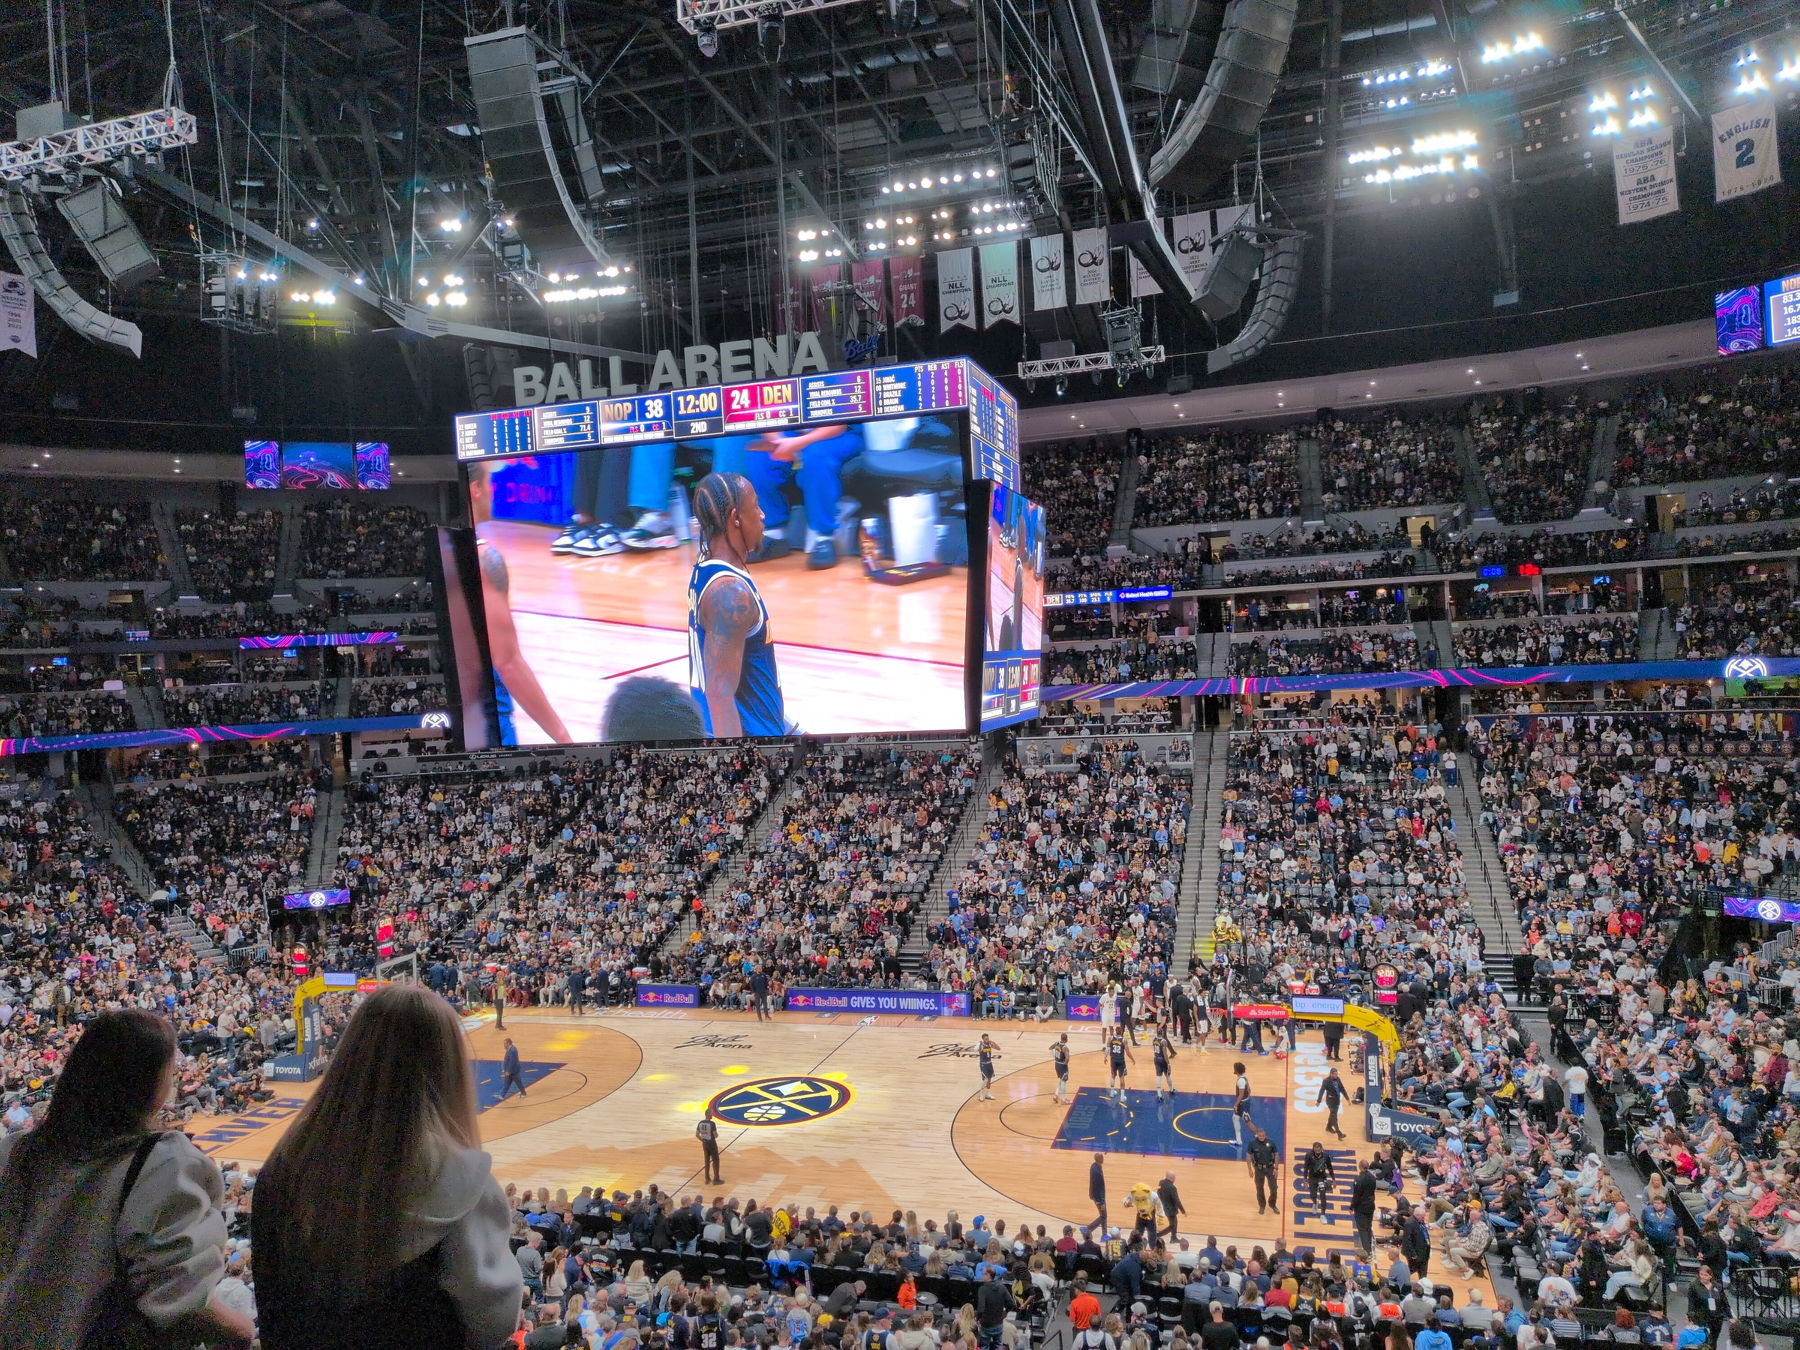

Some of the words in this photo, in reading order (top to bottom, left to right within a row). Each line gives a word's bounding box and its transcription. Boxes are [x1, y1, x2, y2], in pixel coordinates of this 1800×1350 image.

[1718, 118, 1771, 143] ENGLISH
[1616, 150, 1645, 160] REGULAR
[1646, 140, 1672, 153] SEASON
[1633, 138, 1653, 149] ABA
[1626, 150, 1663, 164] CHAMPIONS
[1735, 138, 1755, 169] 2
[1636, 174, 1656, 186] ABA
[1620, 186, 1648, 196] WESTERN
[1649, 178, 1674, 190] DIVISION
[1629, 188, 1666, 202] CHAMPIONS
[1628, 196, 1668, 212] 1974-75
[985, 282, 1014, 290] CHAMPIONS
[991, 276, 1008, 284] NLL
[899, 283, 917, 291] GRANT
[942, 287, 971, 295] CHAMPIONS
[900, 293, 916, 308] 24
[842, 334, 881, 363] Ball
[513, 356, 637, 407] BALL
[648, 332, 829, 391] ARENA
[854, 385, 861, 393] 12
[678, 392, 718, 414] 12:00
[731, 389, 750, 409] 24
[763, 384, 792, 405] DEN
[849, 394, 862, 403] 35.7
[604, 402, 632, 422] NOP
[644, 399, 664, 419] 38
[755, 412, 764, 420] FLS
[766, 410, 771, 419] 0
[778, 410, 786, 418] CC
[789, 408, 794, 416] 1
[640, 424, 645, 432] 0
[662, 422, 666, 430] 1
[690, 421, 708, 434] 2ND
[1047, 595, 1060, 604] DEN
[998, 668, 1004, 690] 38
[664, 994, 679, 1003] Red
[680, 994, 694, 1004] Bull
[815, 996, 832, 1006] Red
[832, 996, 848, 1006] Bull
[851, 996, 876, 1009] GIVES
[878, 997, 897, 1010] YOU
[900, 998, 938, 1010] WIIINGS.
[1312, 1002, 1341, 1011] energy
[584, 1009, 689, 1020] uchealth
[674, 1034, 749, 1049] Ball
[1112, 1045, 1121, 1054] 32
[308, 1054, 328, 1070] xfinit
[275, 1066, 302, 1074] TOYOTA
[1368, 1055, 1378, 1086] UMB
[1109, 1244, 1121, 1256] 15
[702, 1332, 716, 1348] 32
